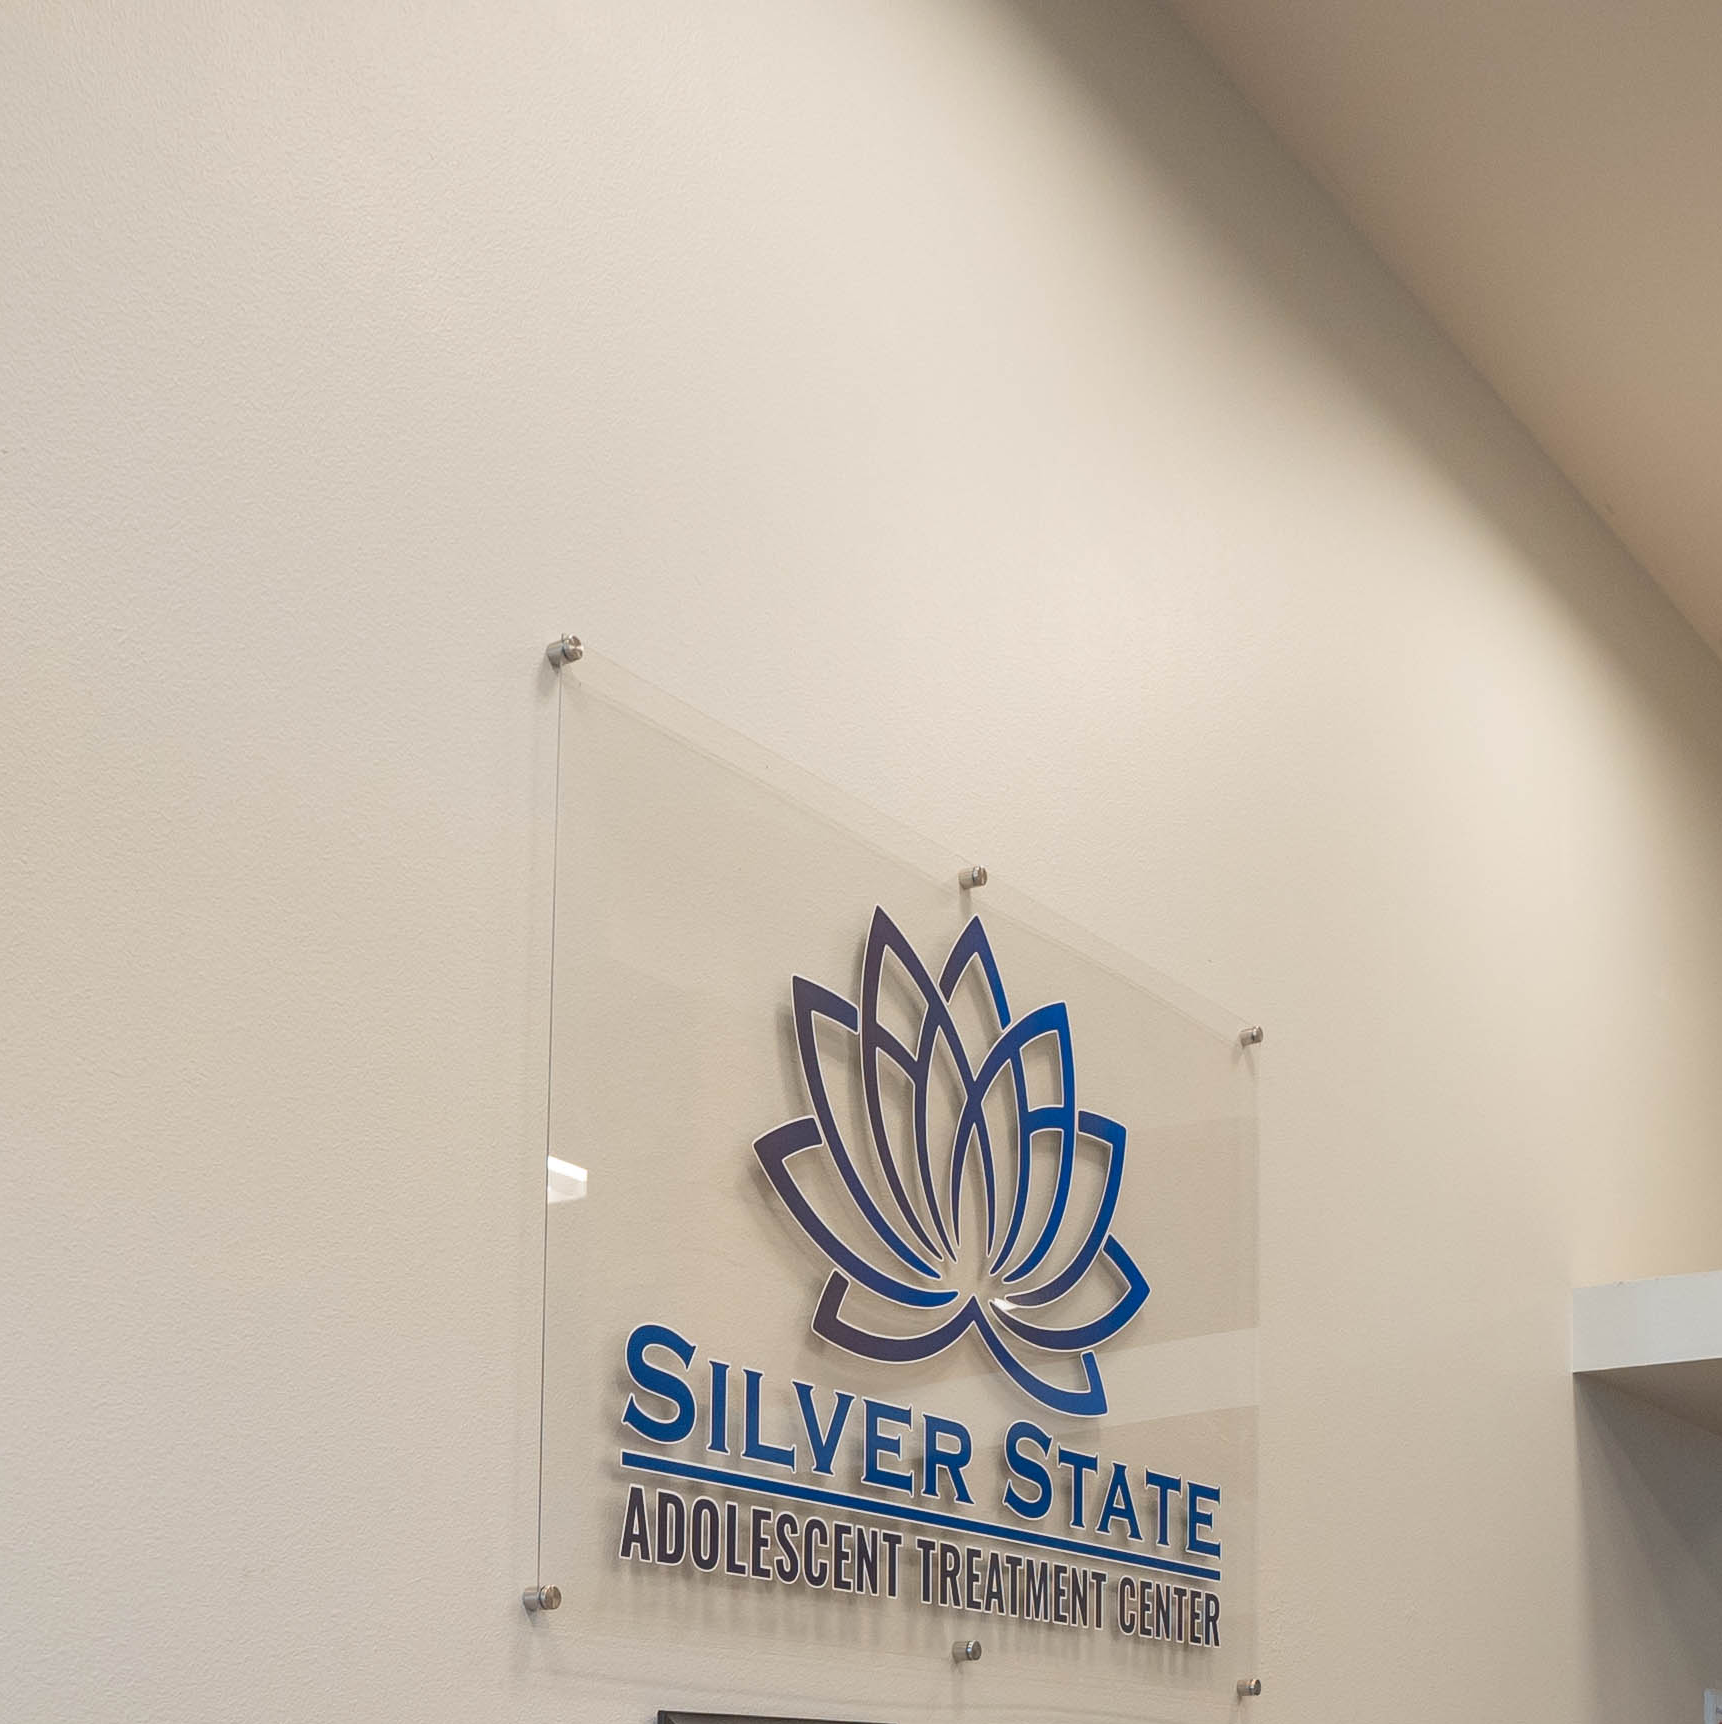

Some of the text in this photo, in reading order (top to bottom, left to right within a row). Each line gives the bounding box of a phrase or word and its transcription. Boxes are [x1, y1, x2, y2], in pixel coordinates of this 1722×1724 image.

[621, 1324, 1222, 1560] SILVER STATE
[620, 1485, 1222, 1647] ADOLESCENT TREATMENT CENTER
